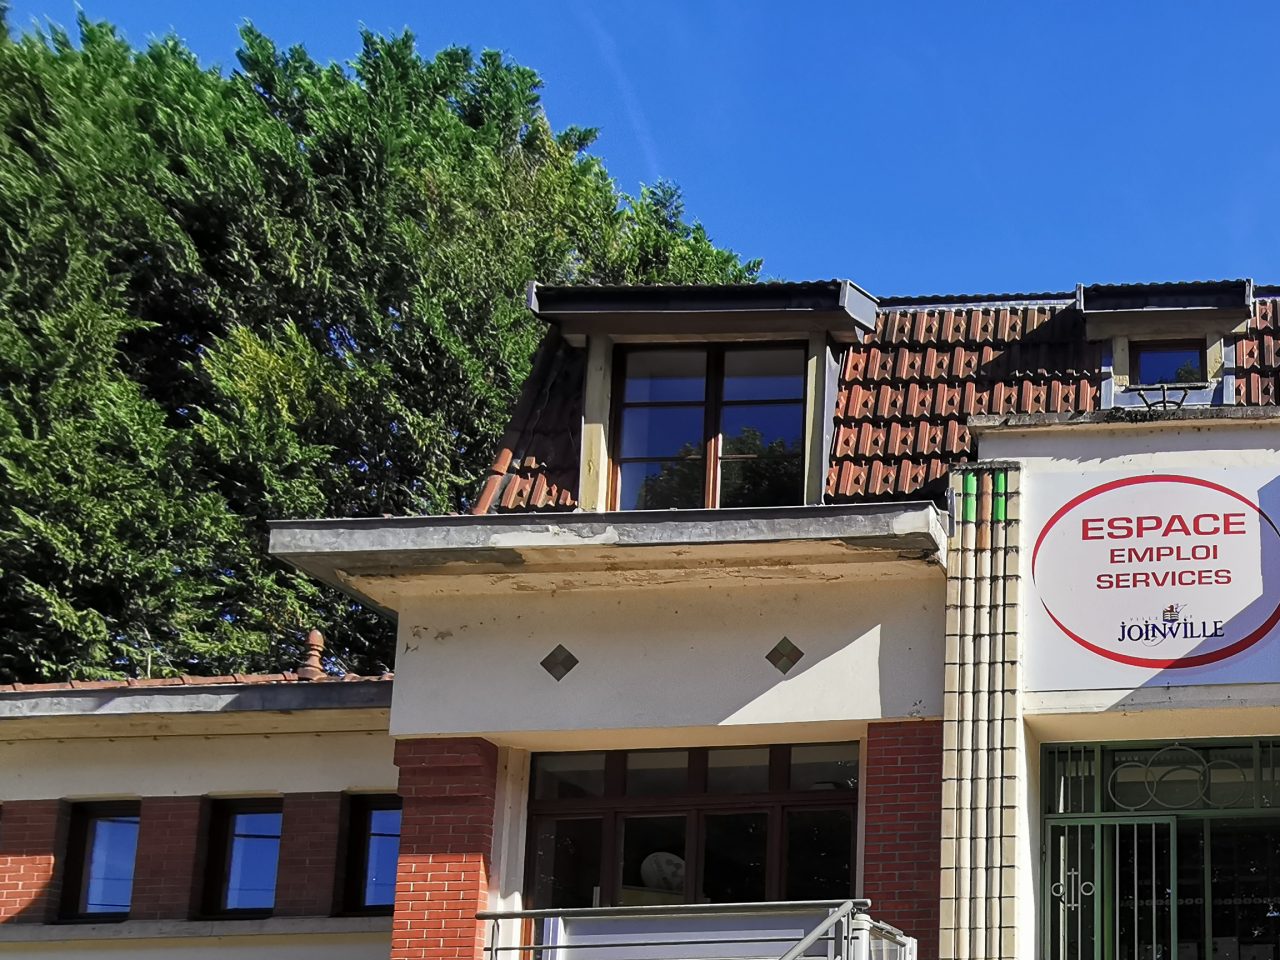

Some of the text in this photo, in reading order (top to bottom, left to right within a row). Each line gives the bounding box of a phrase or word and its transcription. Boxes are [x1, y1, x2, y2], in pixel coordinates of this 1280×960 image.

[1081, 512, 1247, 541] ESPACE
[1109, 544, 1218, 564] EMPLOI
[1096, 569, 1232, 590] SERVICES
